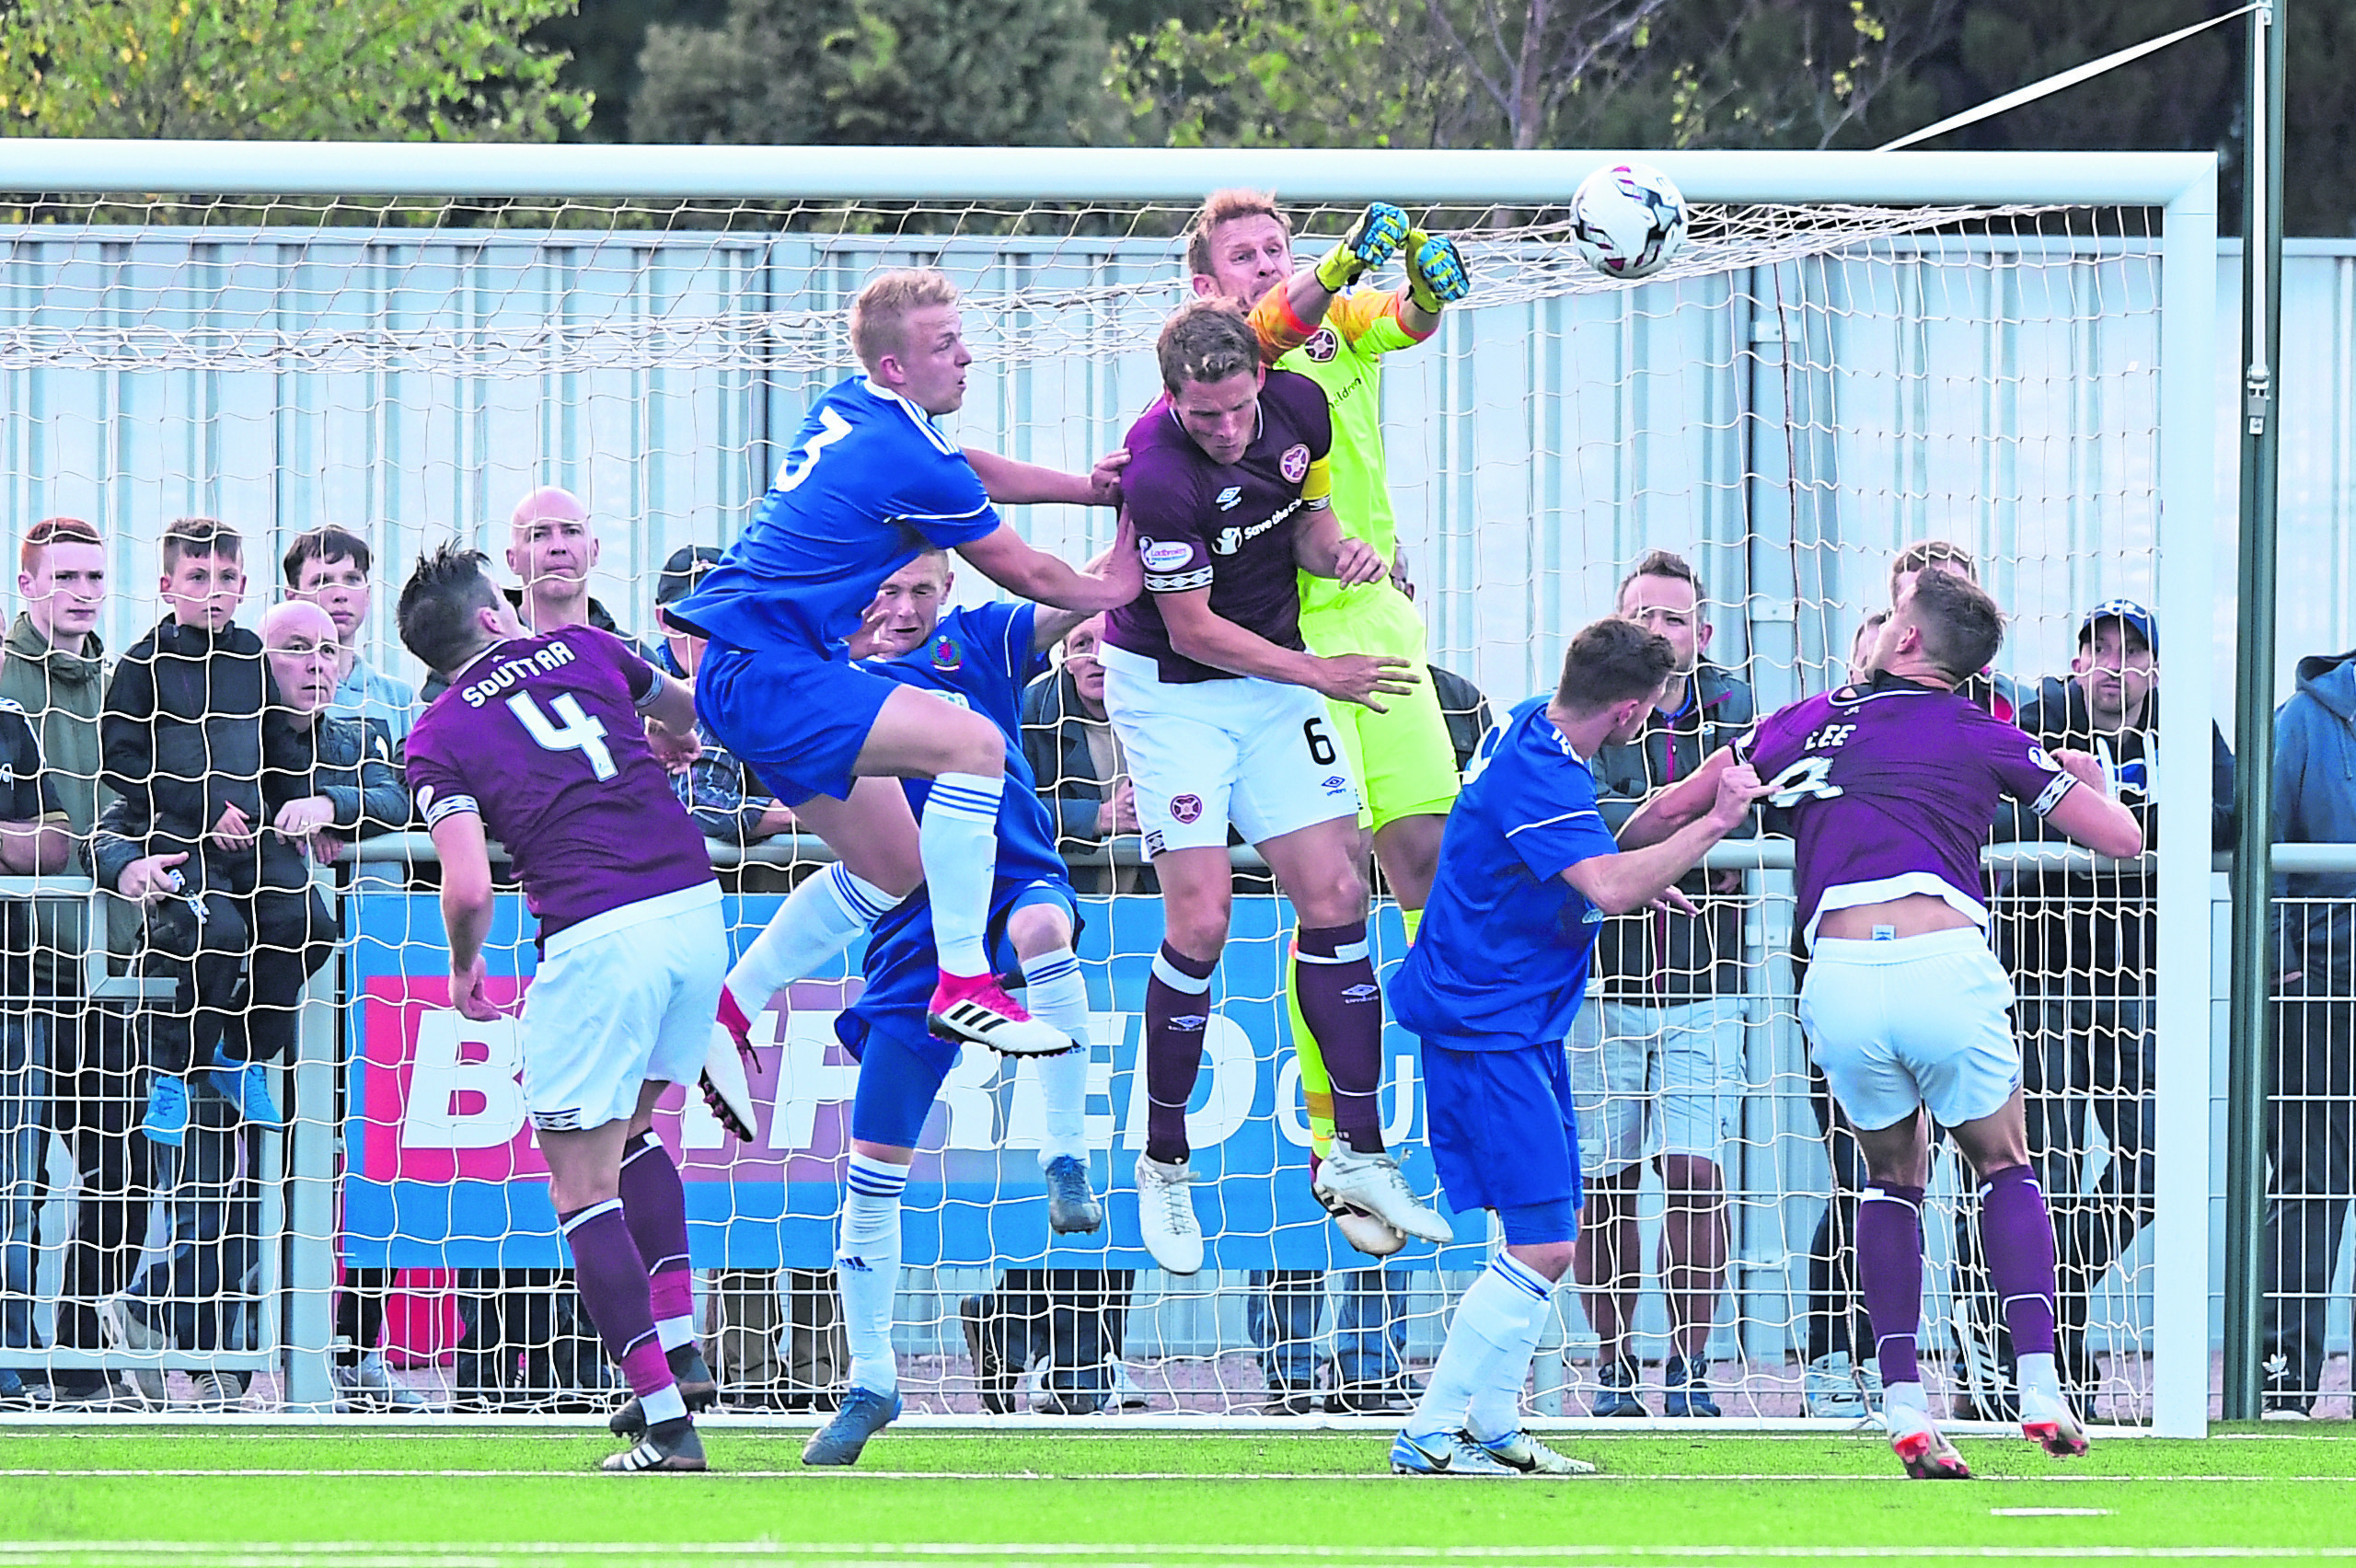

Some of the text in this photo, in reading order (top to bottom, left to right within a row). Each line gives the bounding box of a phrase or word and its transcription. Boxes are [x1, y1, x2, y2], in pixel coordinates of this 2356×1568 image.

[774, 405, 854, 492] 3
[1243, 508, 1289, 540] Save the
[461, 640, 576, 709] SOUTTAR
[504, 689, 619, 782] 4
[1303, 717, 1336, 766] 6
[1804, 724, 1857, 751] LEE
